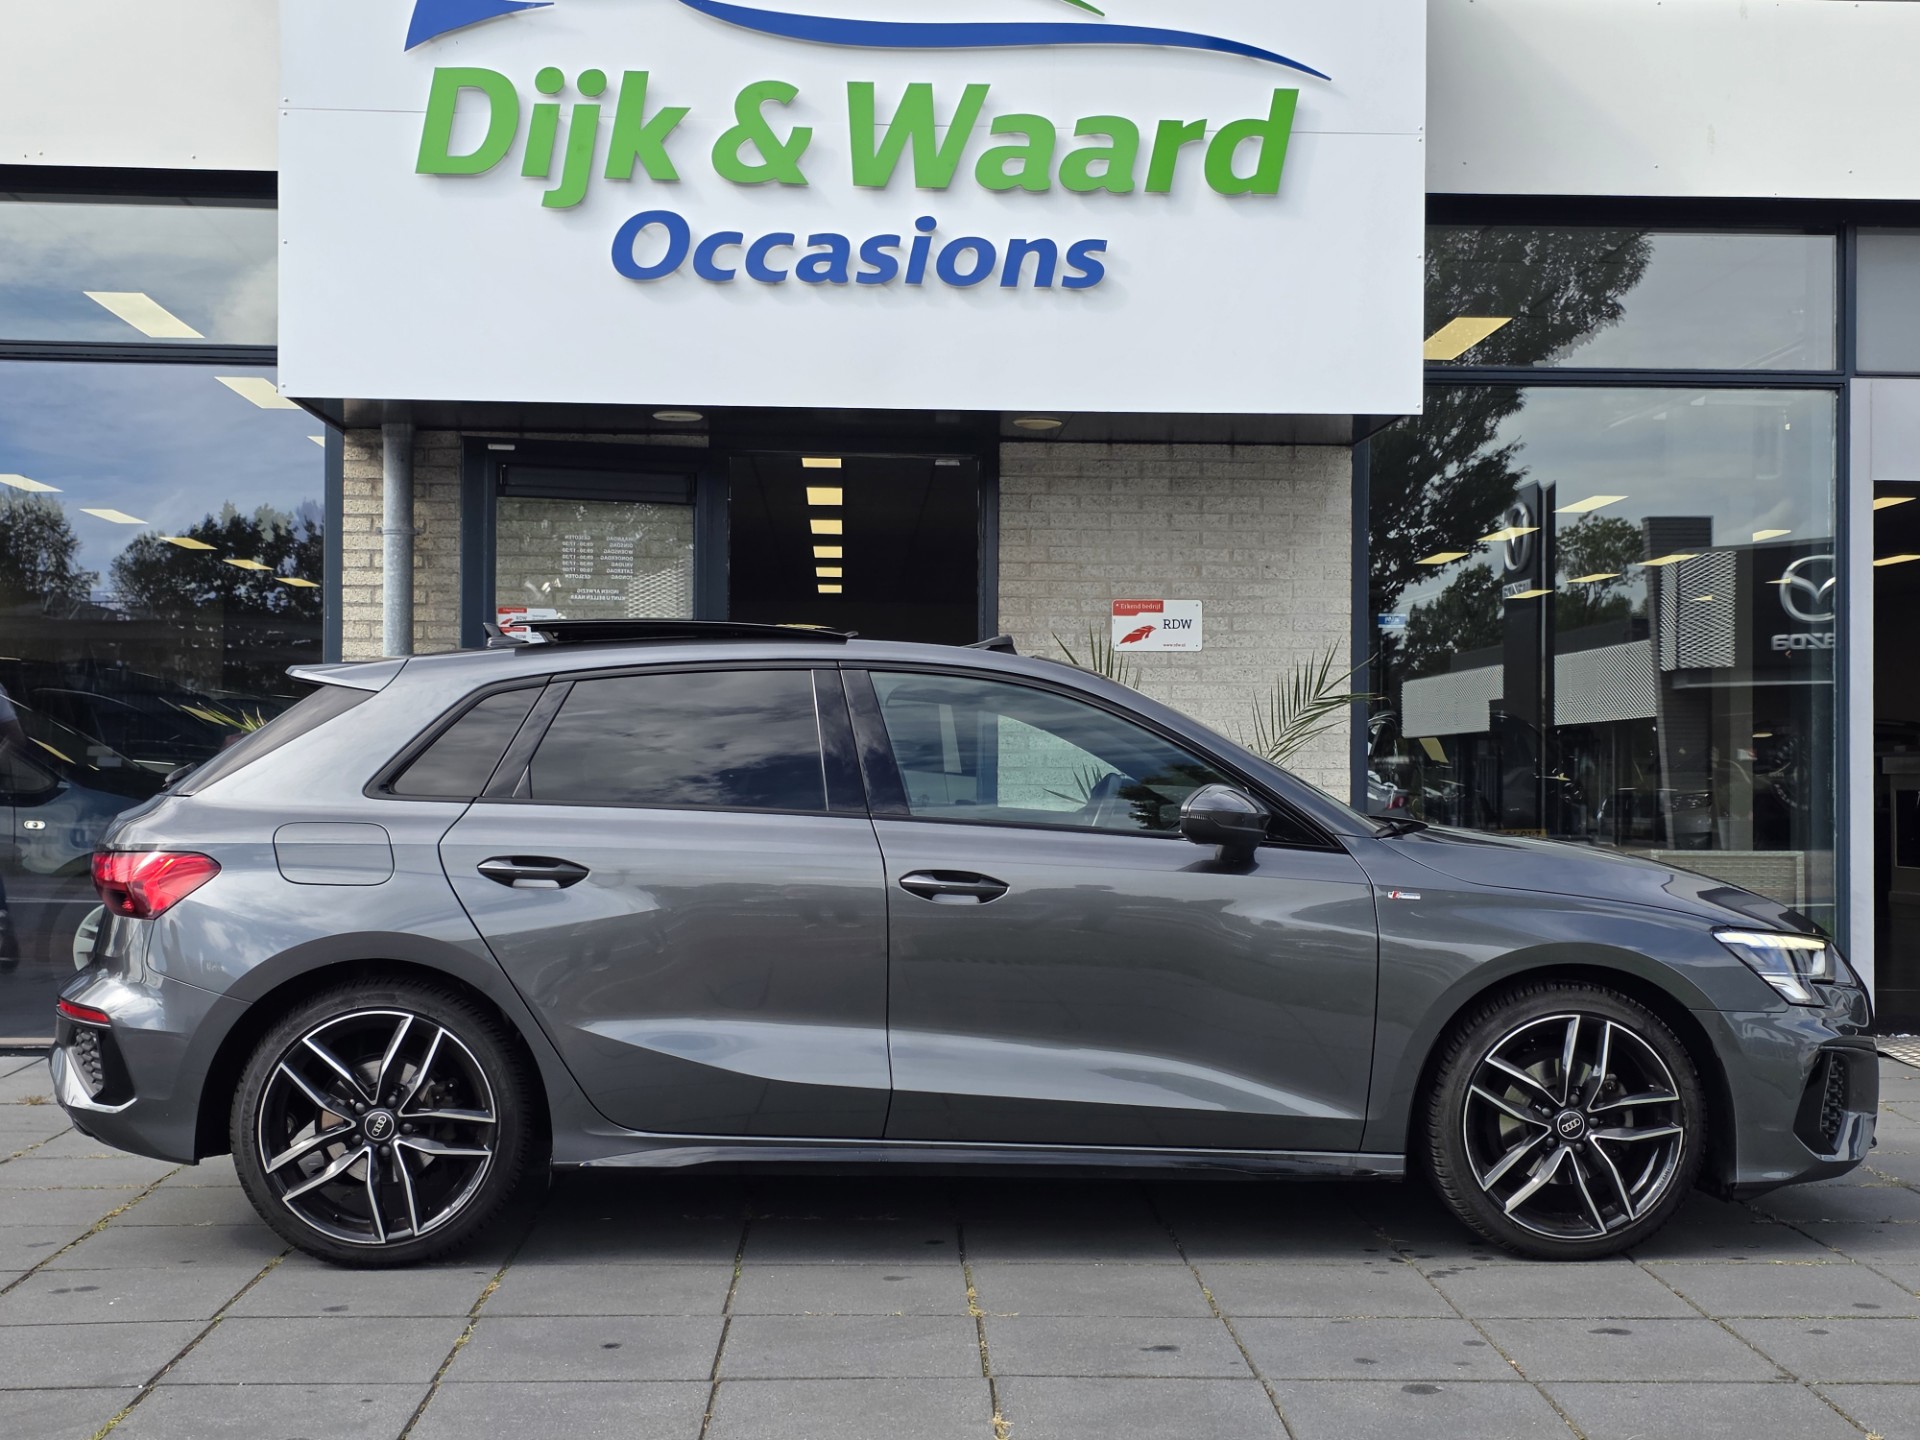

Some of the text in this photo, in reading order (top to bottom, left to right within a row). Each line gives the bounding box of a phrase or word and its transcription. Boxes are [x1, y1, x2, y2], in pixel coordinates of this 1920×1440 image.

[415, 67, 1300, 207] Dijk & Waard
[612, 211, 1106, 288] Occasions
[1163, 619, 1192, 629] RDW
